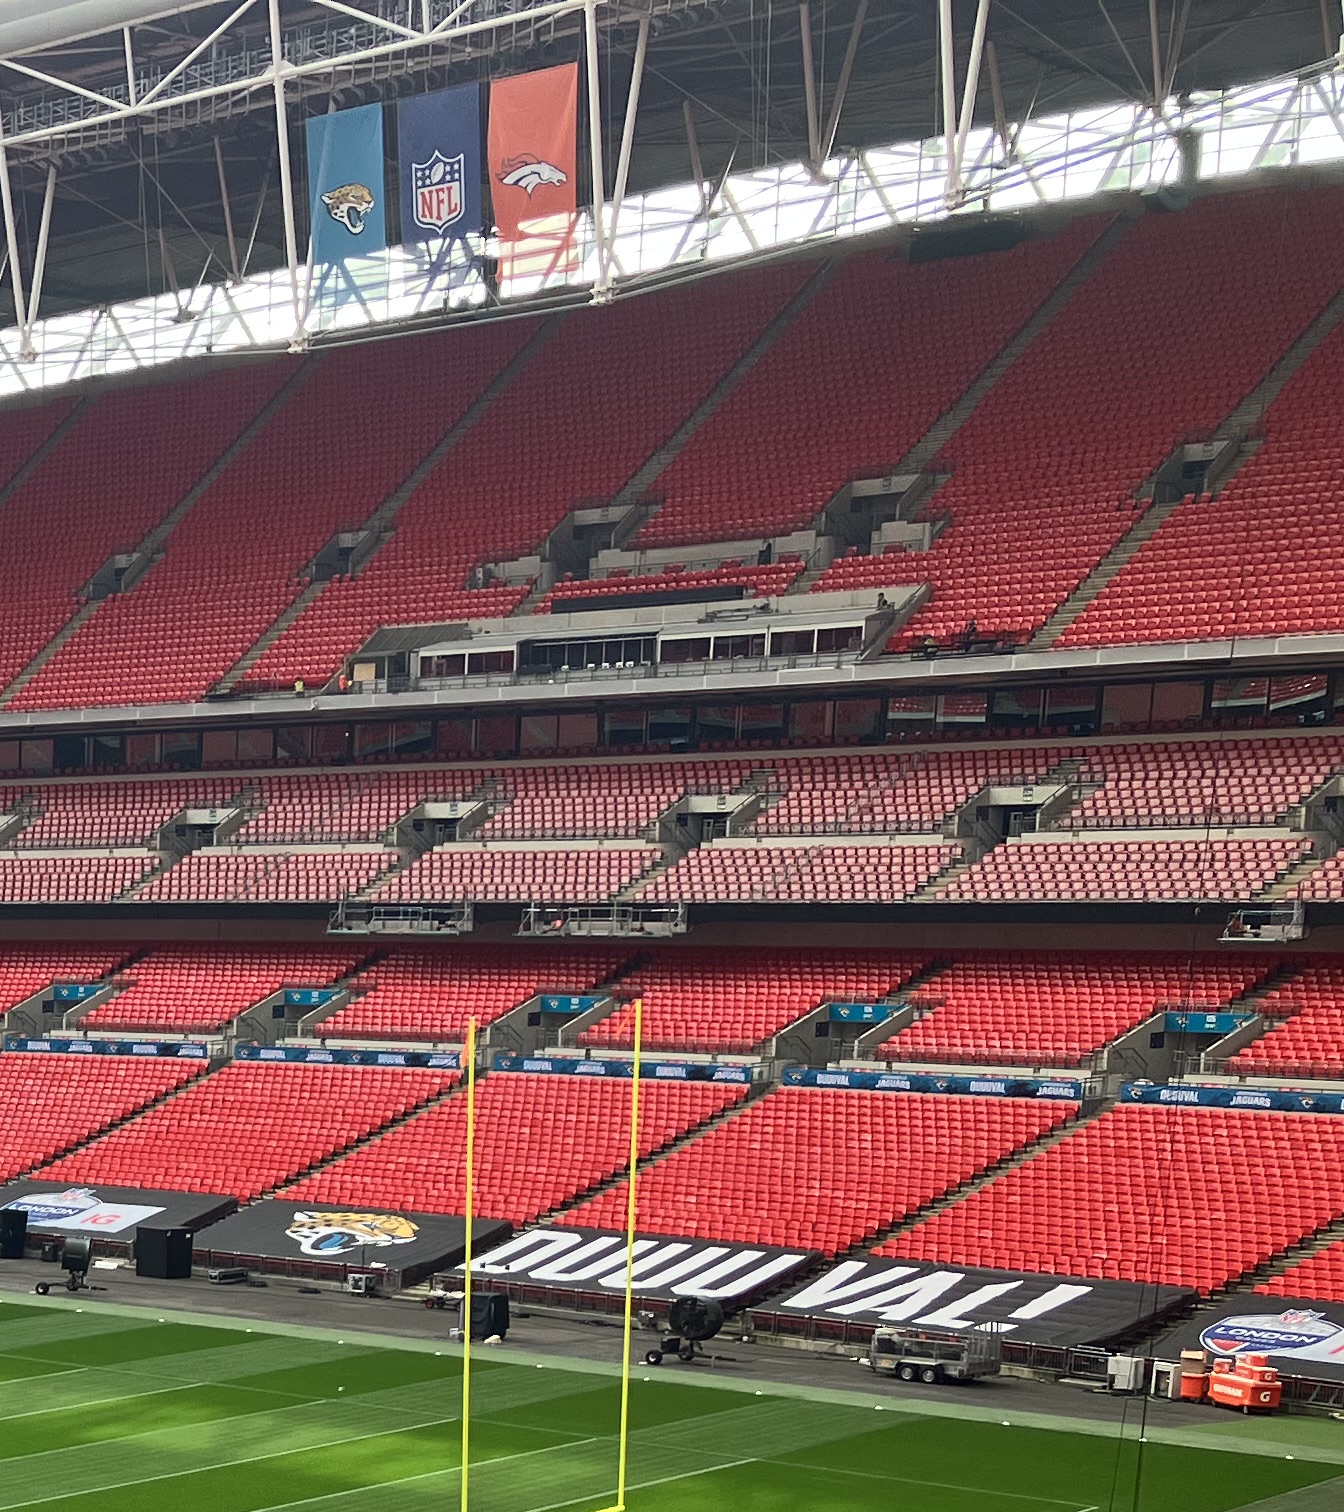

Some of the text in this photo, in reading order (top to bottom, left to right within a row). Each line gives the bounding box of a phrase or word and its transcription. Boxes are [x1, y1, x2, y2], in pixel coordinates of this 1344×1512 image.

[419, 186, 459, 222] NFL
[1036, 1085, 1076, 1098] JAGUARS
[1230, 1095, 1271, 1108] JAGUARS
[9, 1203, 80, 1216] LONDON
[80, 1213, 121, 1225] IG
[781, 1260, 1094, 1333] VAL!
[1214, 1327, 1318, 1344] LONDON
[1260, 1391, 1271, 1402] G
